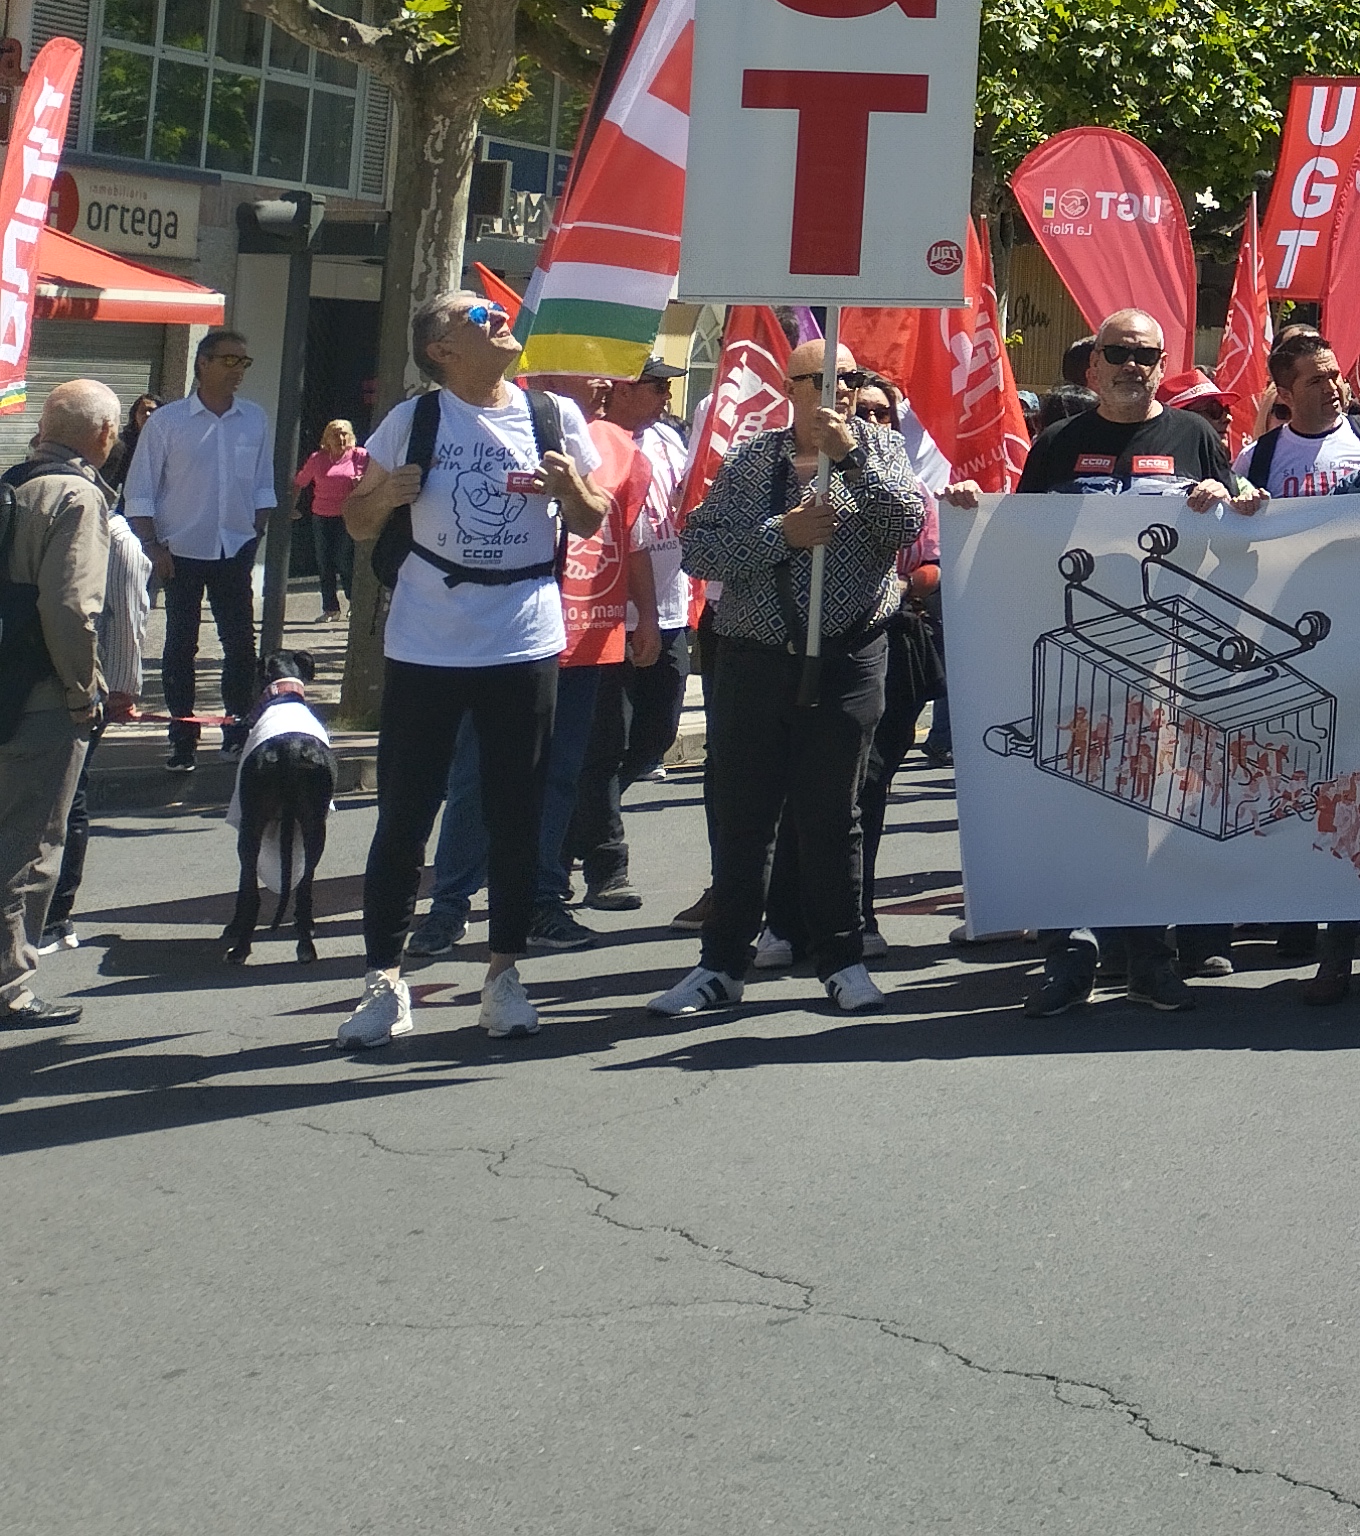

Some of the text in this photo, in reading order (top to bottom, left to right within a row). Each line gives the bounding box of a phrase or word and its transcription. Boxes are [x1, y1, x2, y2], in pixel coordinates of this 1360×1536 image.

[1275, 86, 1357, 289] UGT
[87, 200, 178, 249] ortega
[931, 246, 958, 262] UGT
[438, 442, 464, 457] No
[473, 442, 516, 460] llego
[435, 456, 461, 472] fin
[471, 455, 492, 472] de
[512, 476, 533, 485] CC
[437, 530, 529, 547] y lo sabes
[462, 548, 504, 559] CCOO
